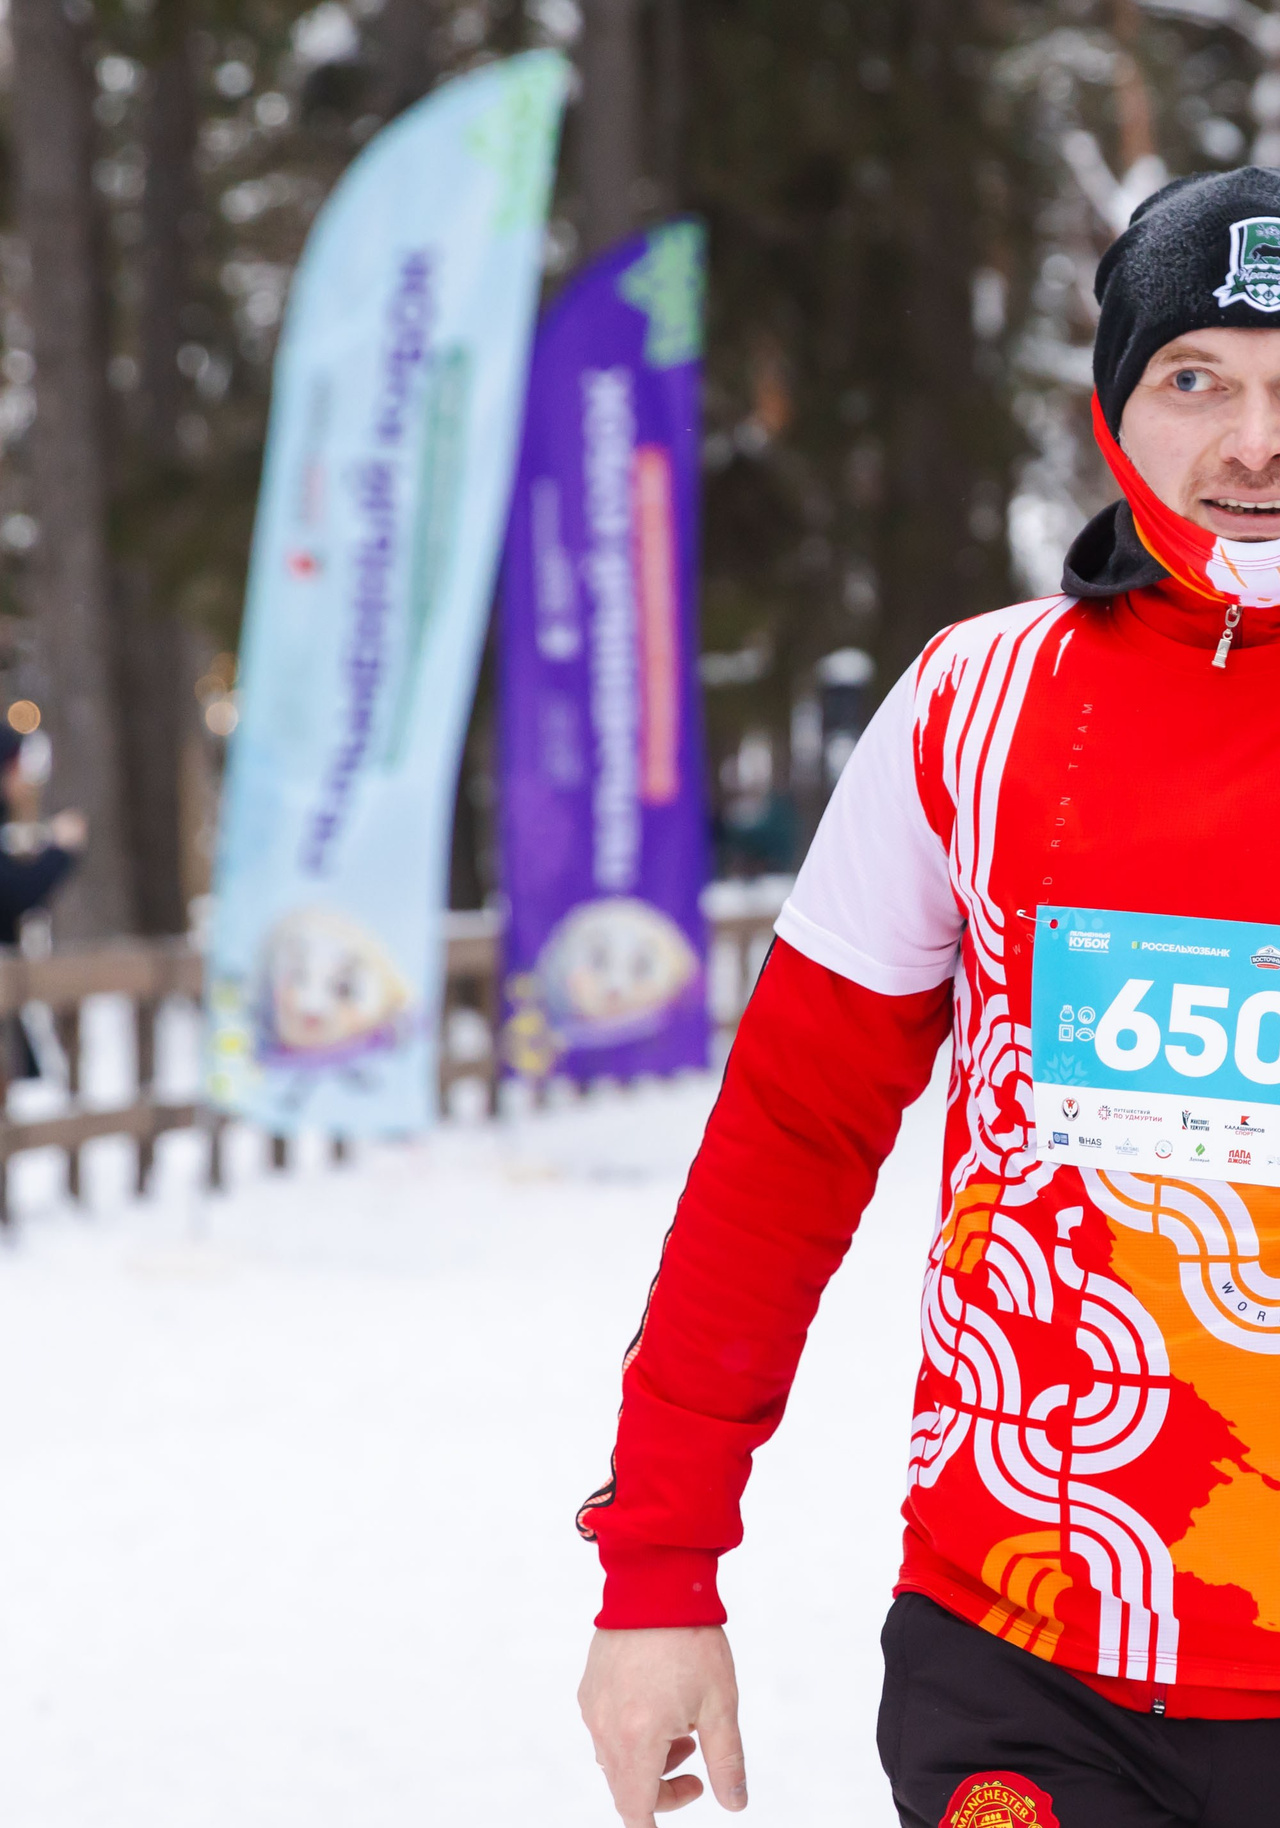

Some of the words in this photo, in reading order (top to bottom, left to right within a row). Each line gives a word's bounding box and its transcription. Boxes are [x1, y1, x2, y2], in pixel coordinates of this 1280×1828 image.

[1013, 876, 1053, 955] WOLD
[1050, 797, 1071, 848] RUN
[1068, 703, 1093, 770] TEAM
[1069, 936, 1110, 950] КУБОК
[1141, 941, 1230, 957] РОССЕЛЬХОЗБАНК
[1125, 1114, 1163, 1122] УДМУРТИИ
[1224, 1124, 1265, 1133] КАЛАШНИКОВ
[1085, 1137, 1102, 1146] HAS
[1229, 1149, 1252, 1159] ПАПА
[1227, 1157, 1252, 1165] ДЖОНС
[957, 1789, 1029, 1828] MANCHESTER
